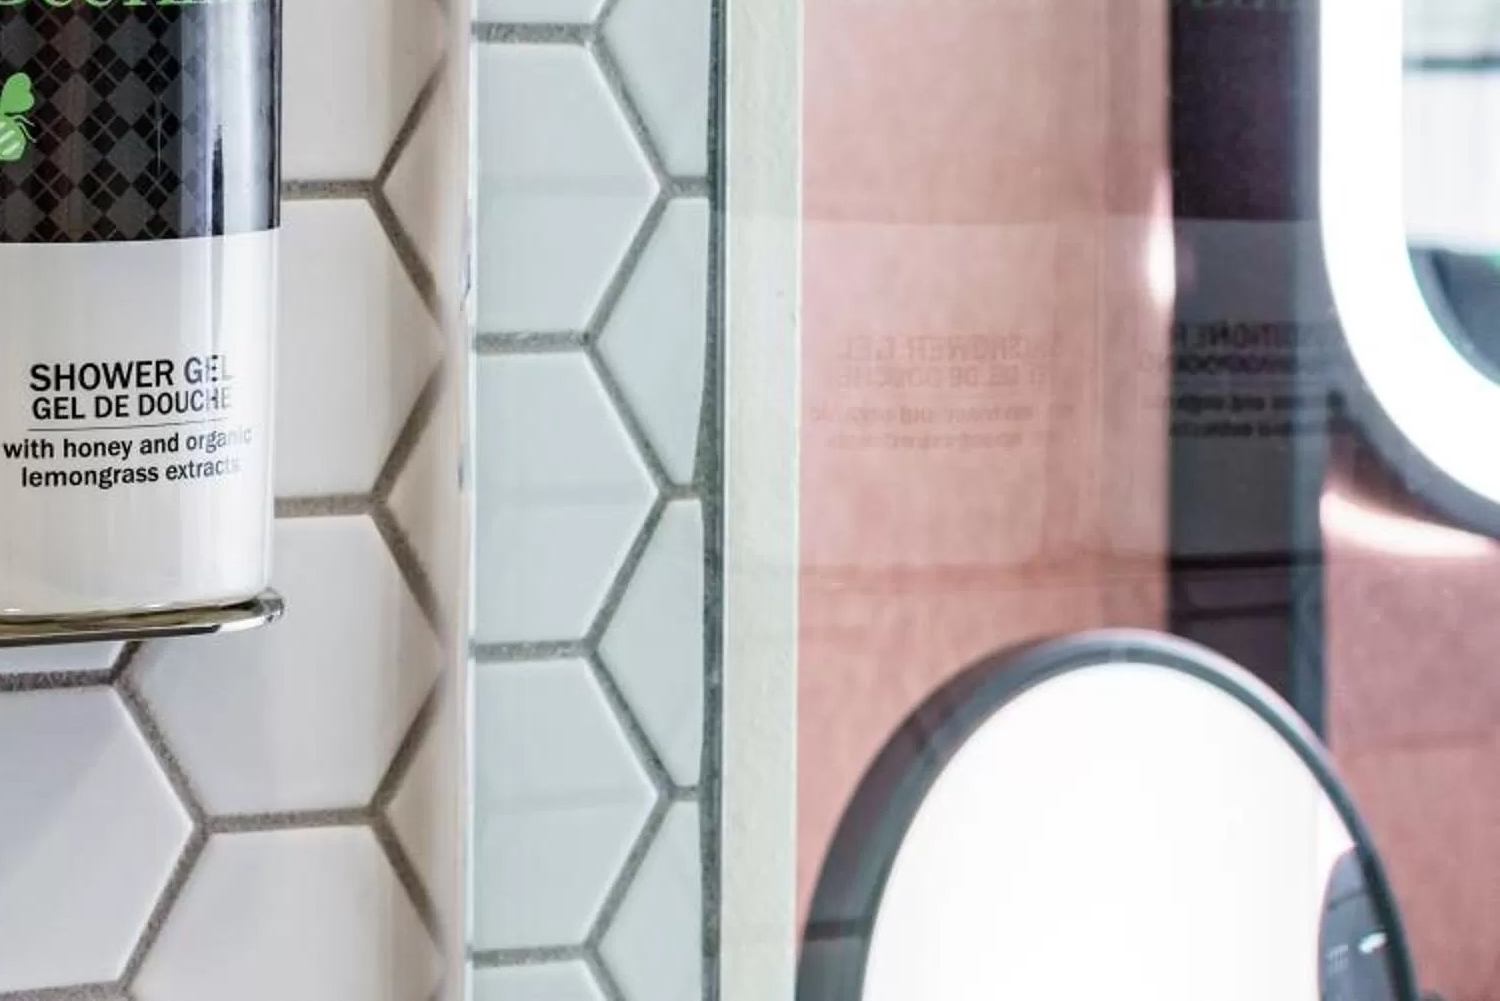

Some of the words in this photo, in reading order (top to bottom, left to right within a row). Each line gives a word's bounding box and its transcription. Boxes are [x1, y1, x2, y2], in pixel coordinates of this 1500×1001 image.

[29, 359, 175, 392] SHOWER
[184, 354, 234, 385] GEL
[32, 396, 86, 421] GEL
[94, 394, 130, 418] DE
[138, 386, 232, 417] DOUCHE
[3, 438, 54, 459] with
[63, 437, 133, 460] honey
[139, 432, 180, 455] and
[186, 426, 253, 454] organic
[22, 465, 159, 490] lemongrass
